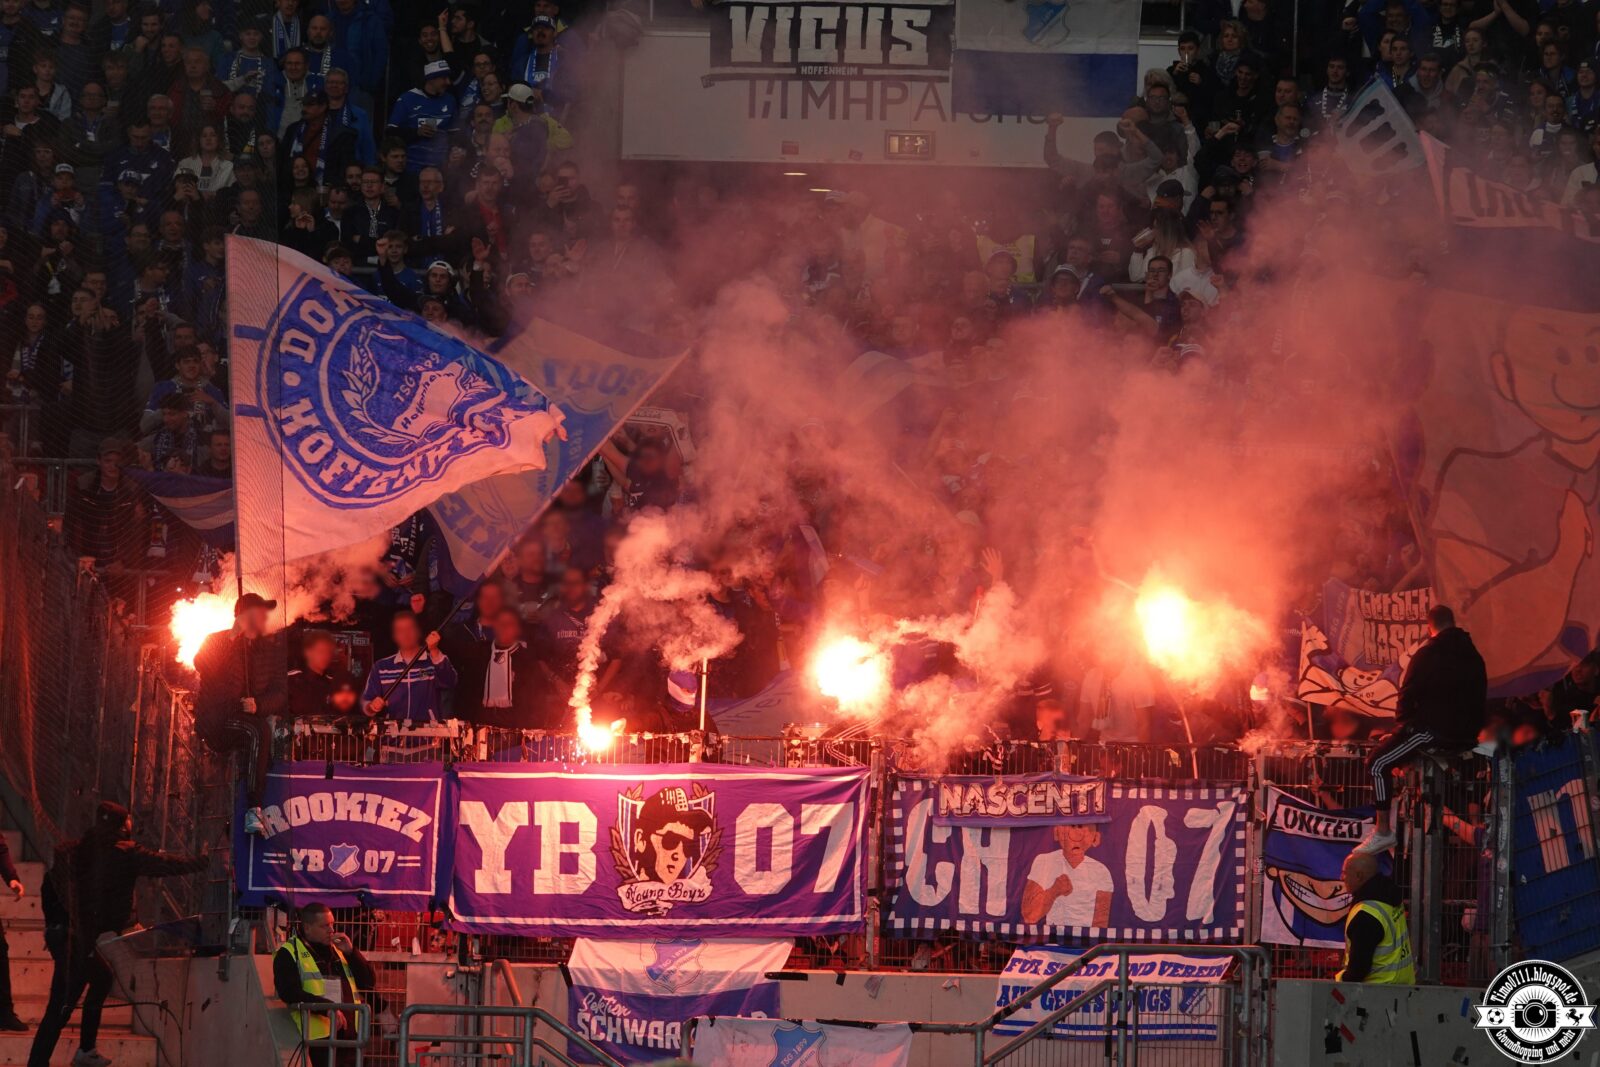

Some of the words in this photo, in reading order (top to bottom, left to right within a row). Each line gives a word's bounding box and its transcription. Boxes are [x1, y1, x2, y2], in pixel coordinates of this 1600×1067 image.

[801, 66, 858, 76] HOFFENHEIM
[393, 376, 417, 403] TSG
[939, 781, 1106, 817] NASCENTI
[262, 791, 432, 842] ROOKIEZ
[1283, 807, 1363, 840] UNITED
[289, 848, 325, 872] YB
[364, 849, 395, 873] 07
[459, 800, 598, 895] YB
[734, 802, 854, 895] 07
[1124, 800, 1236, 924] 07
[625, 882, 664, 903] Young
[667, 881, 706, 903] Boyz
[1043, 961, 1113, 977] SADT
[1158, 959, 1226, 978] VEREIN
[578, 991, 632, 1018] Sektion
